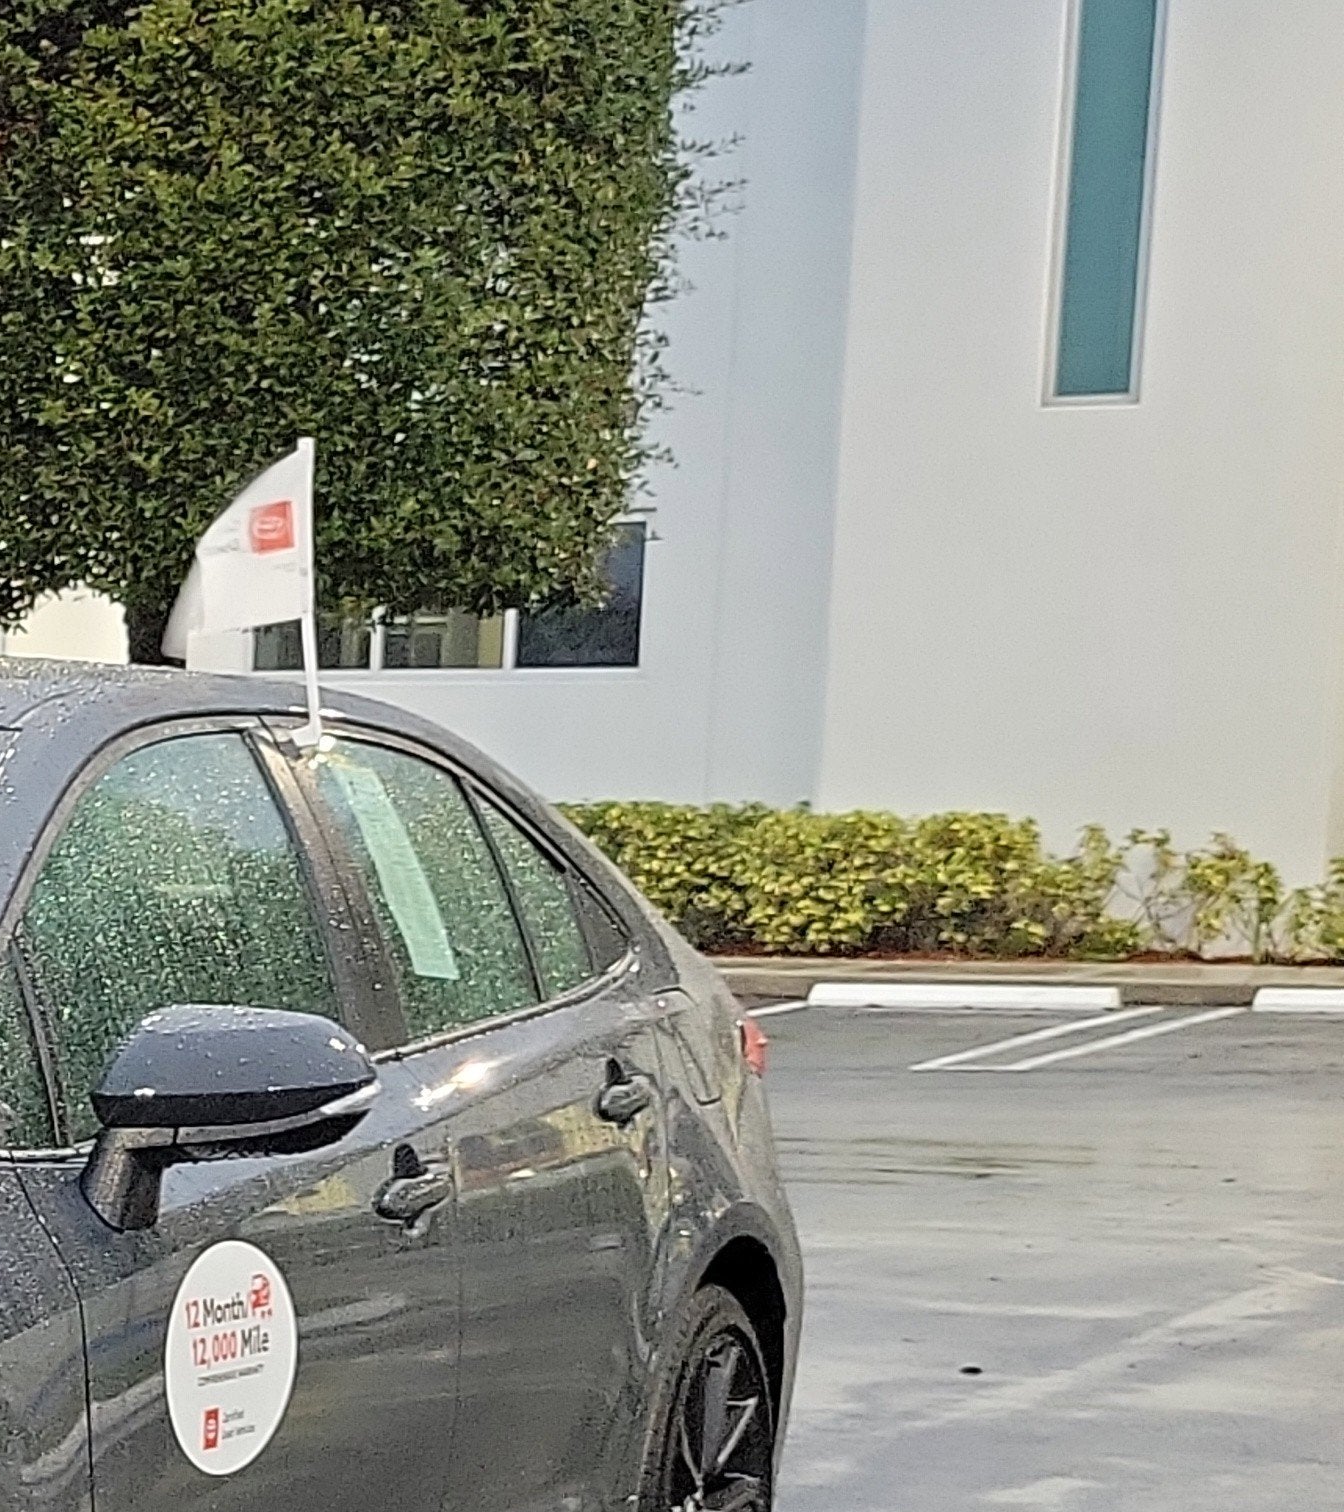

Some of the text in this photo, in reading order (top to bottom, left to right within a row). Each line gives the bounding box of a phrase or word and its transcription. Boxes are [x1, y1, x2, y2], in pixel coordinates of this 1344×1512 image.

[185, 1299, 201, 1329] 12
[192, 1325, 270, 1369] 12,000 Mile
